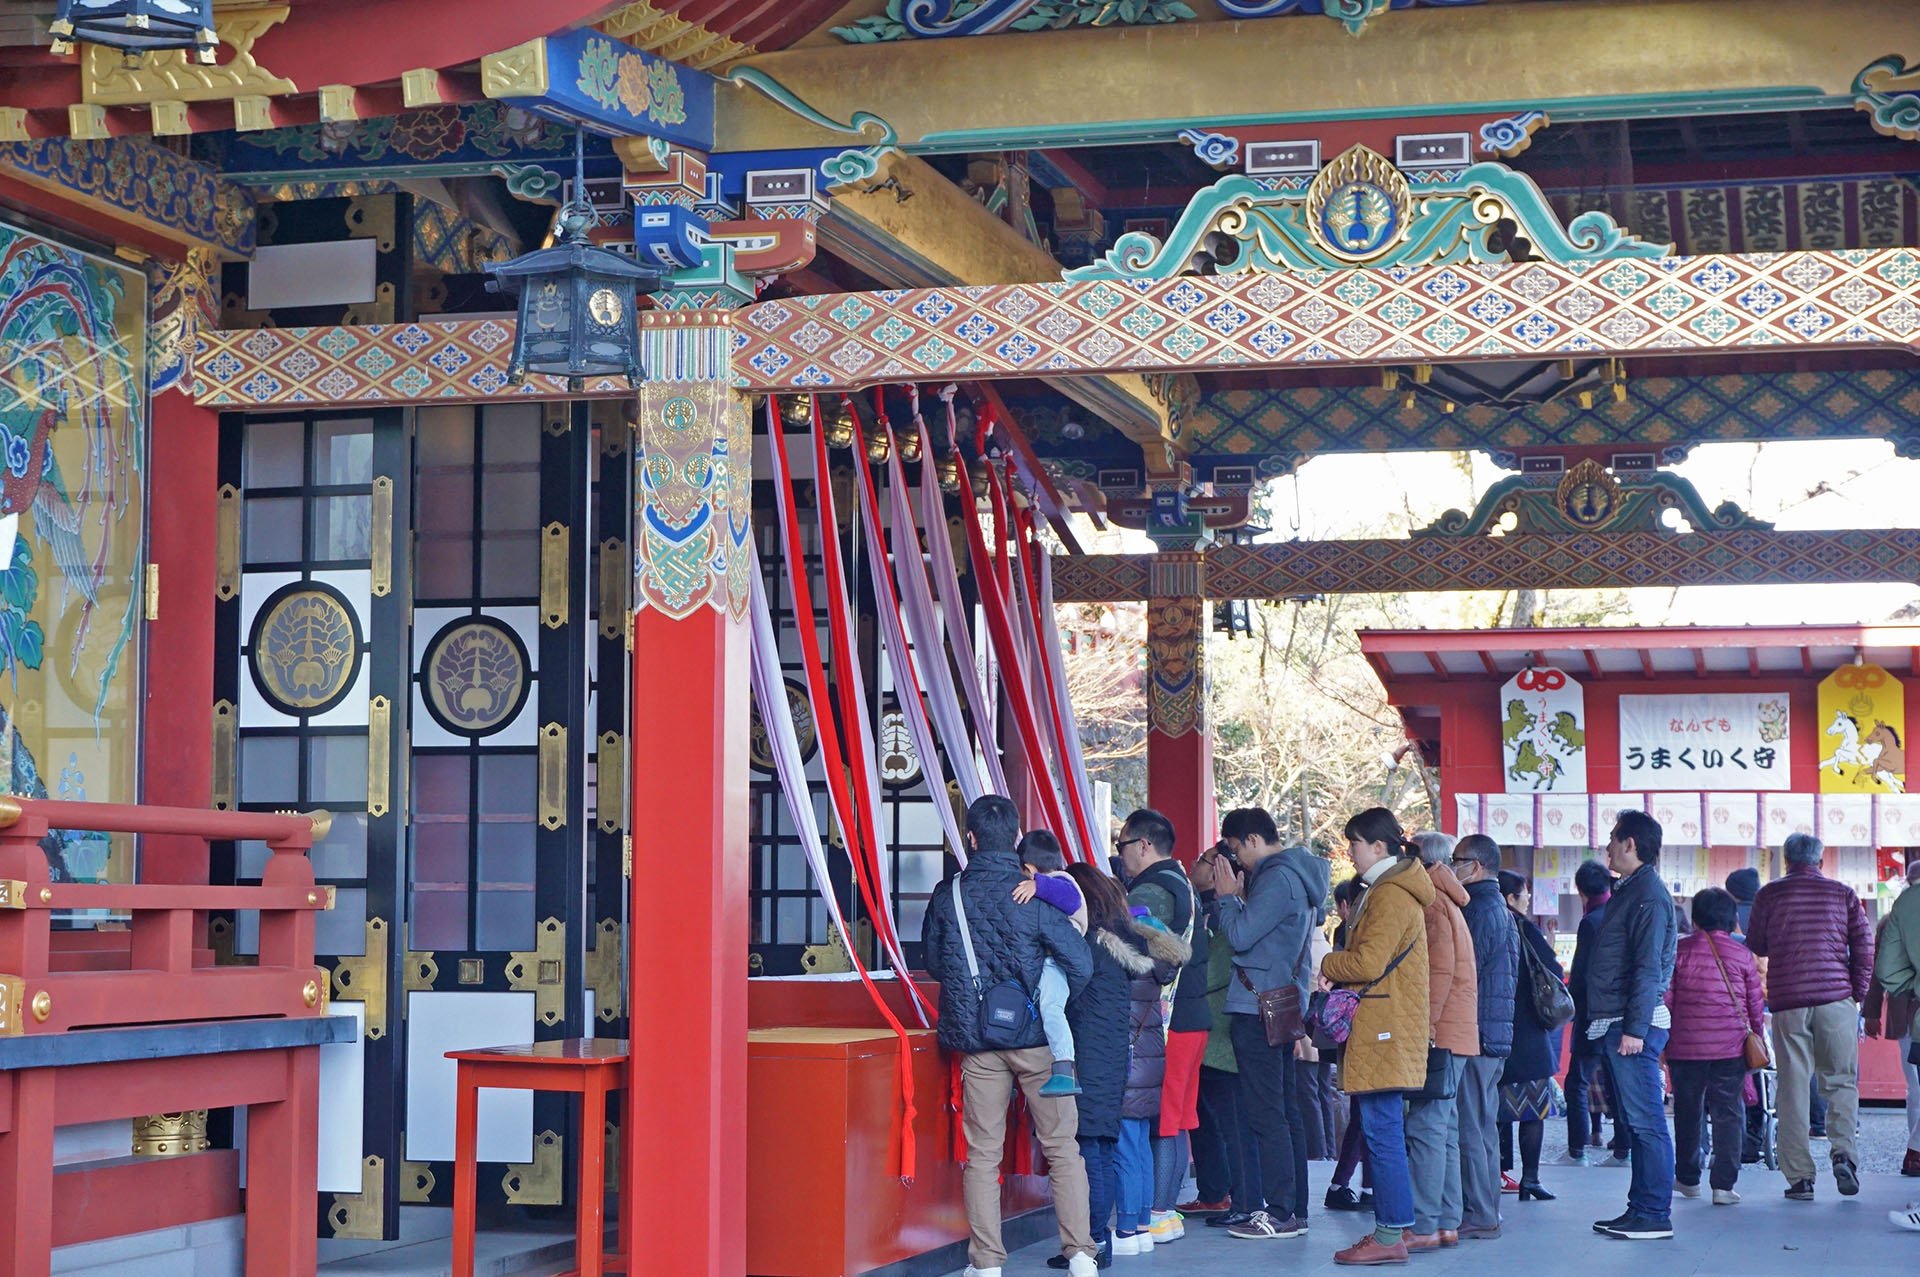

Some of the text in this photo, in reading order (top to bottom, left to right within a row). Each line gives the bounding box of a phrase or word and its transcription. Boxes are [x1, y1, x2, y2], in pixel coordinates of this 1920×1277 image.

[1538, 697, 1553, 776] うまくいく守
[1669, 717, 1732, 733] なんでも
[1626, 747, 1776, 771] うまくいく守
